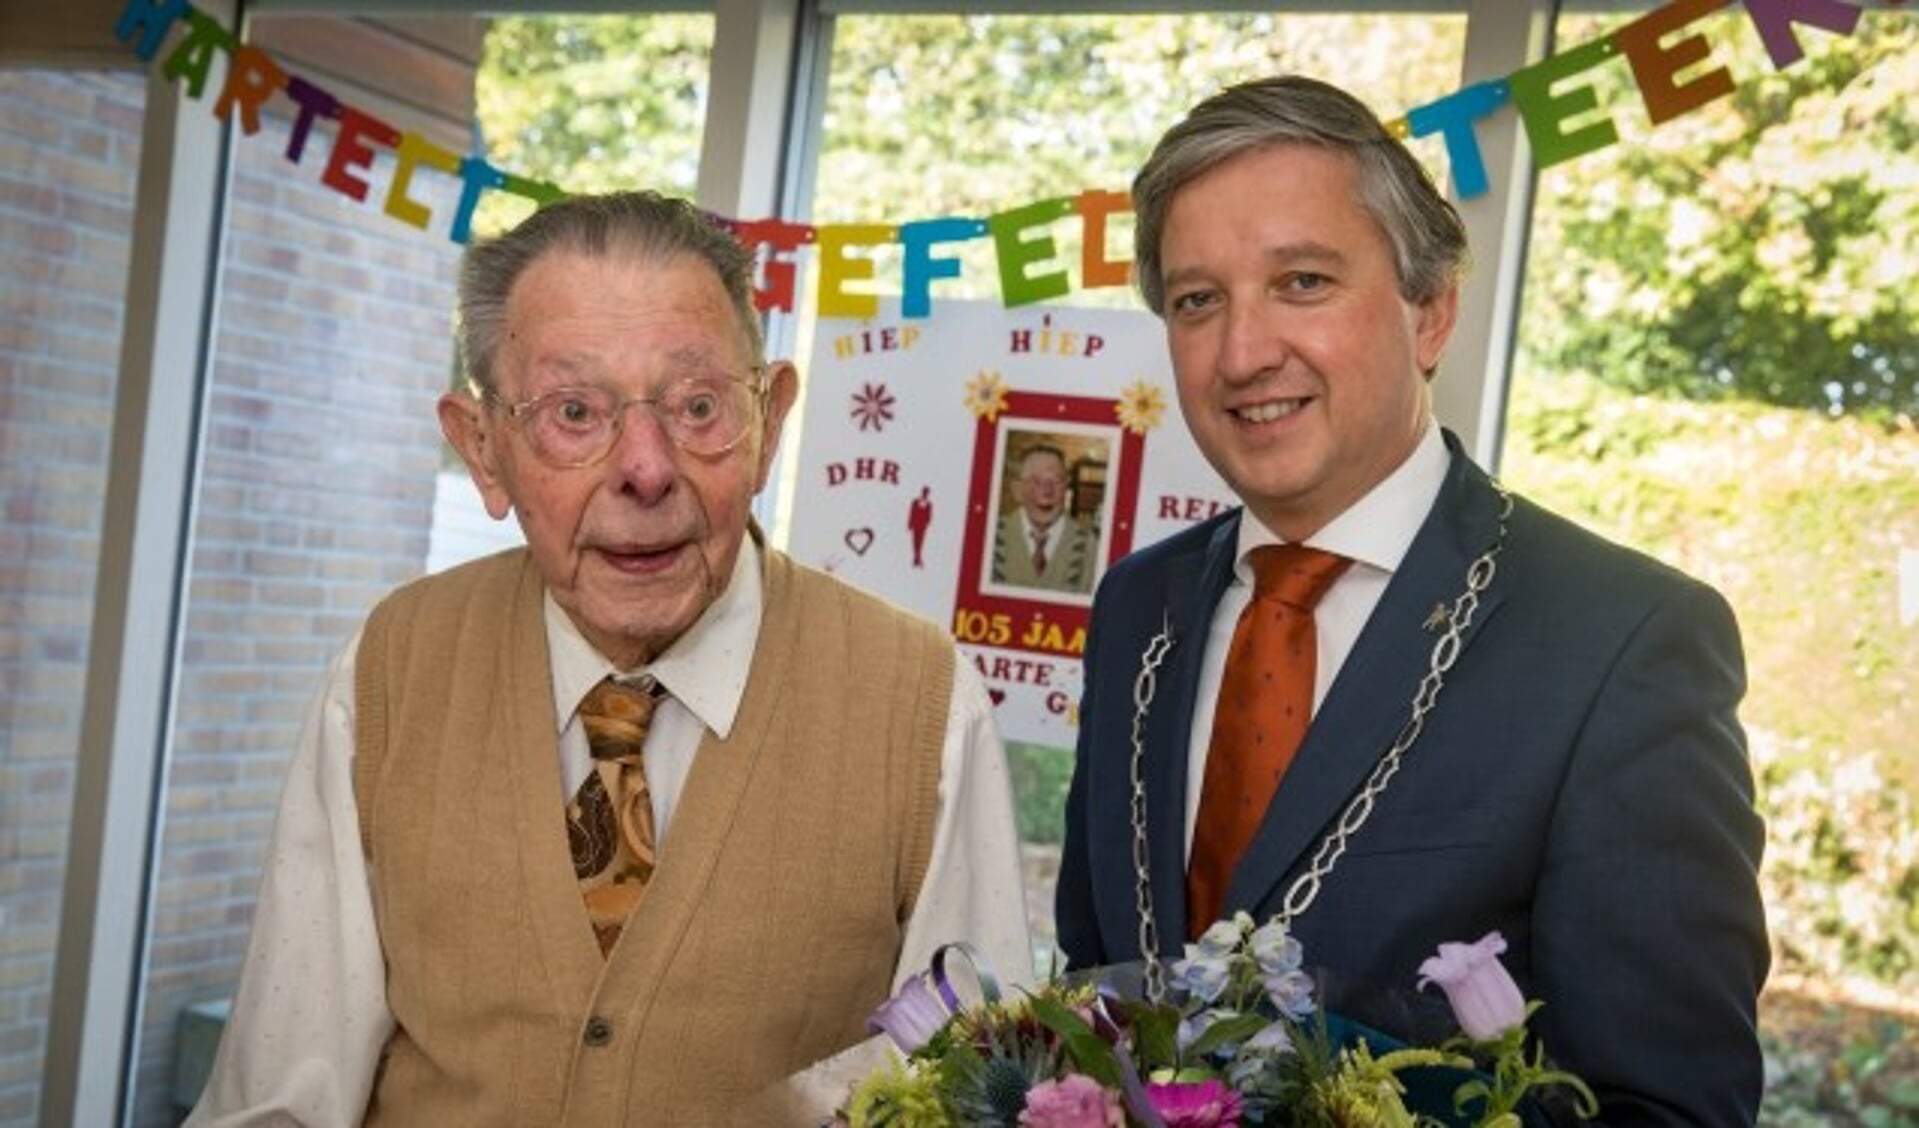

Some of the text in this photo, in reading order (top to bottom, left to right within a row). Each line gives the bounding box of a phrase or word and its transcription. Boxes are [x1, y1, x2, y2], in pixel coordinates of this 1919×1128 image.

[834, 325, 921, 361] HIEP
[826, 457, 901, 487] DHR
[1158, 495, 1235, 520] REI
[956, 608, 1012, 645] 105
